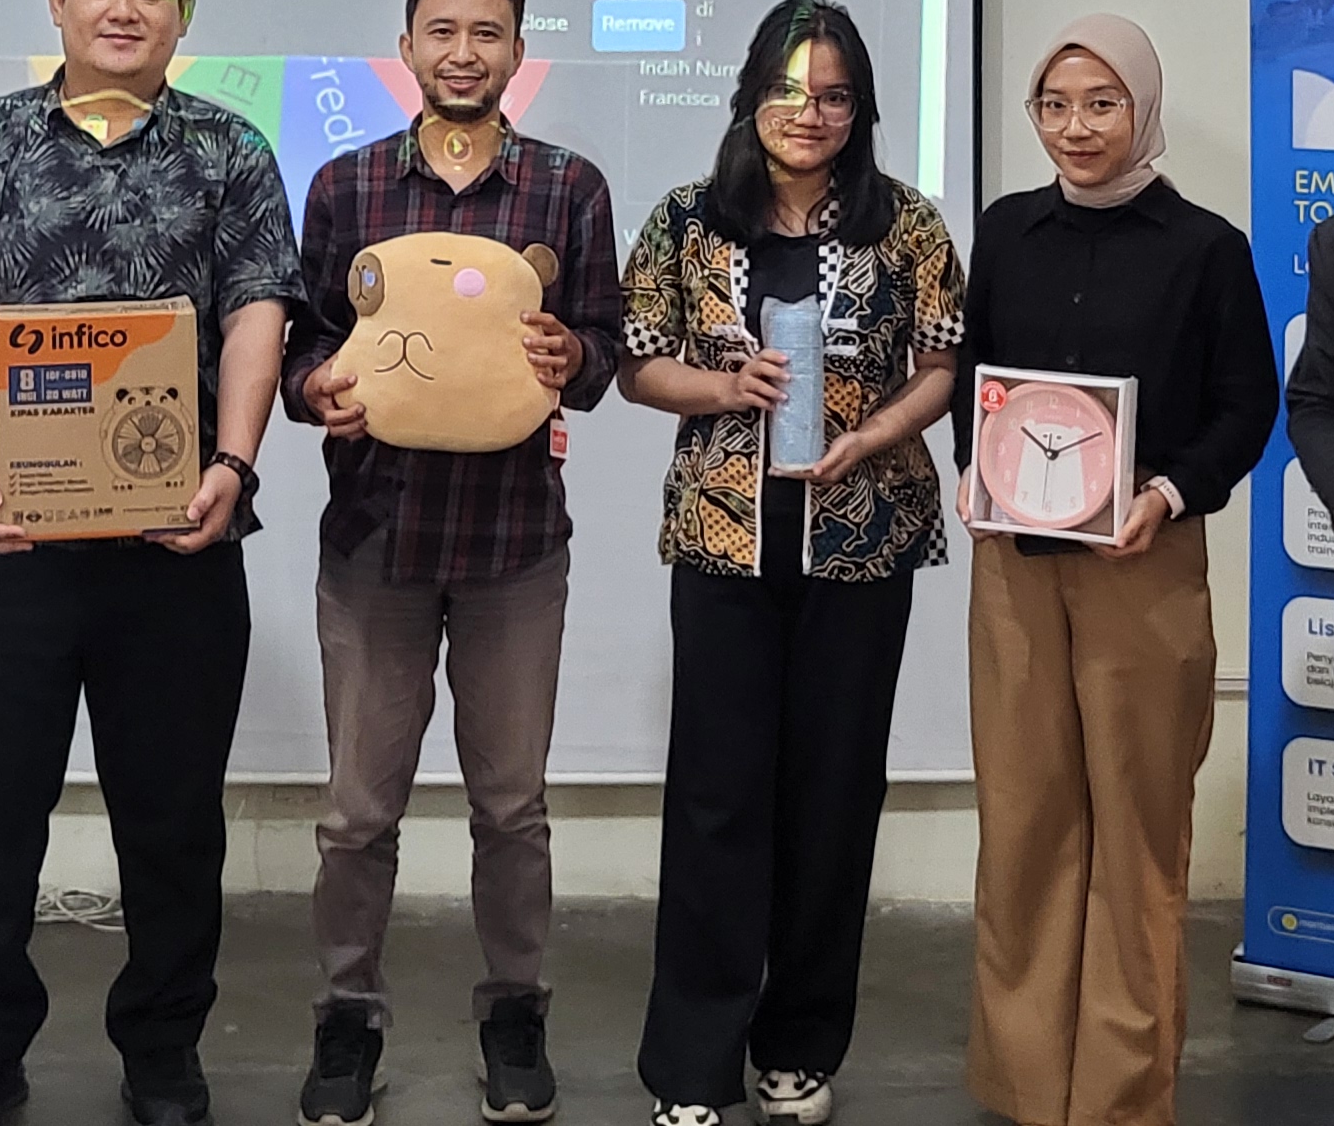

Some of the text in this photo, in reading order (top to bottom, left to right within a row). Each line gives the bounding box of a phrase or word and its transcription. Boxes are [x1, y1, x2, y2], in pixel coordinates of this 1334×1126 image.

[601, 15, 675, 33] Remove
[639, 60, 691, 77] Indah
[639, 87, 720, 107] Francisca
[1293, 199, 1332, 224] TO
[51, 322, 128, 351] infico
[19, 368, 35, 391] 8
[61, 388, 88, 400] WATT
[9, 406, 96, 418] KIPAS KARAKTER
[1308, 757, 1327, 777] IT
